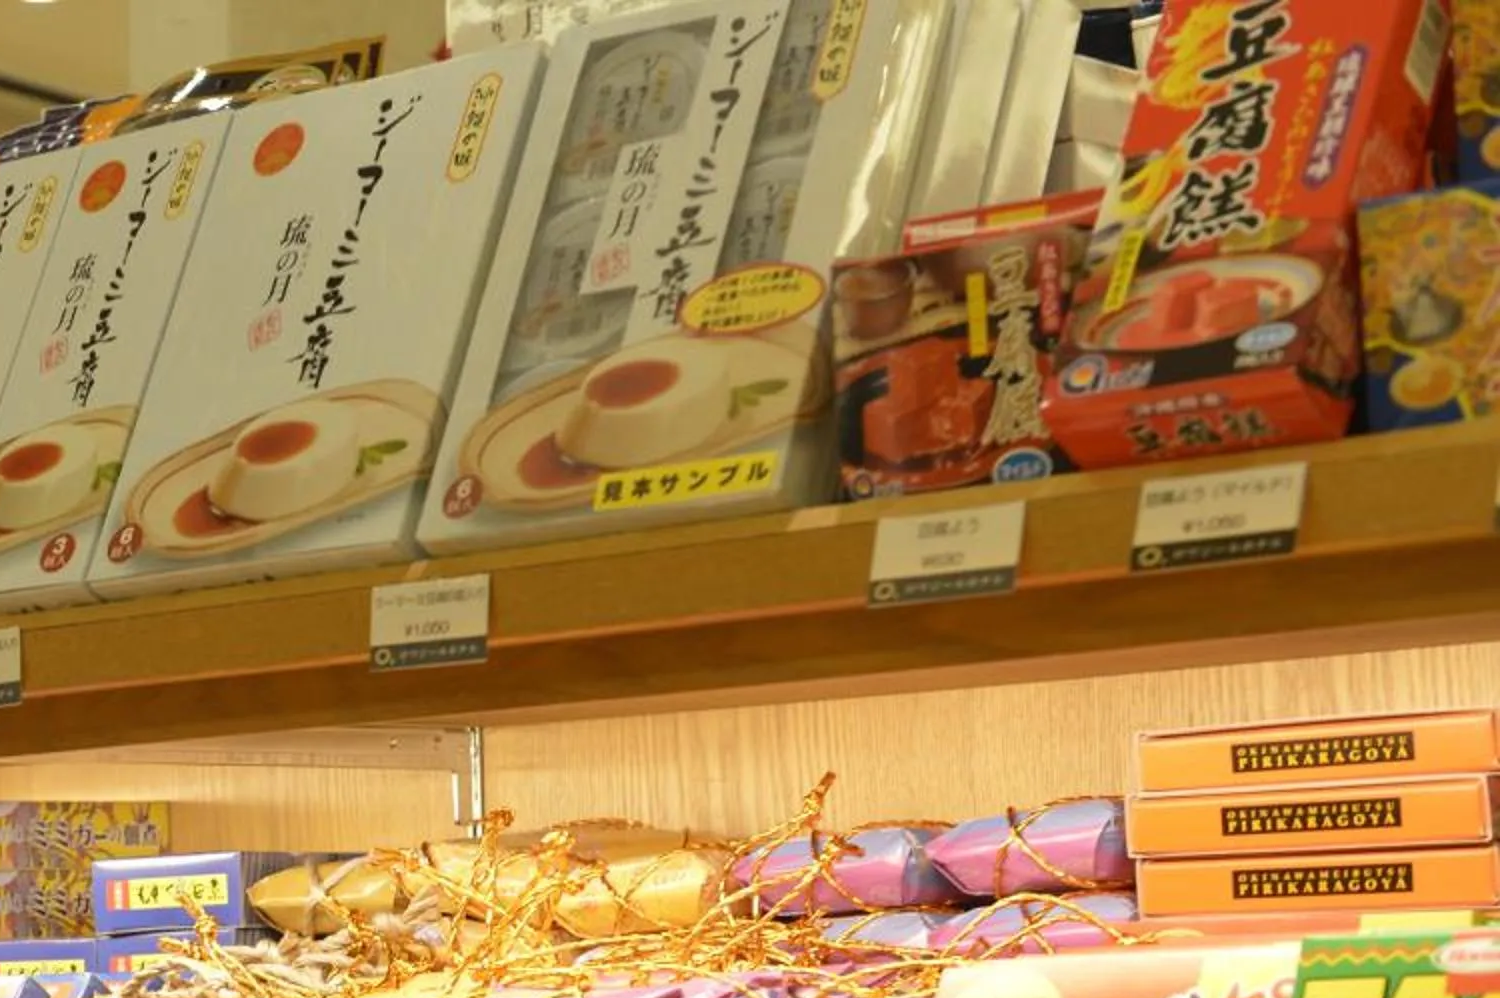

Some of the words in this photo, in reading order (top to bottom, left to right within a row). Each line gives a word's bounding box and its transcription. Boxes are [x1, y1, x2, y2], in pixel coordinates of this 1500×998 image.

[610, 146, 659, 239] 琉の月
[263, 217, 310, 306] 琉の月
[52, 254, 97, 333] 琉の月
[1238, 745, 1410, 769] PIRIKARAGOYA
[1226, 809, 1398, 833] PIRIKARAGOYA
[1238, 875, 1411, 898] PIRIKARAGOYA
